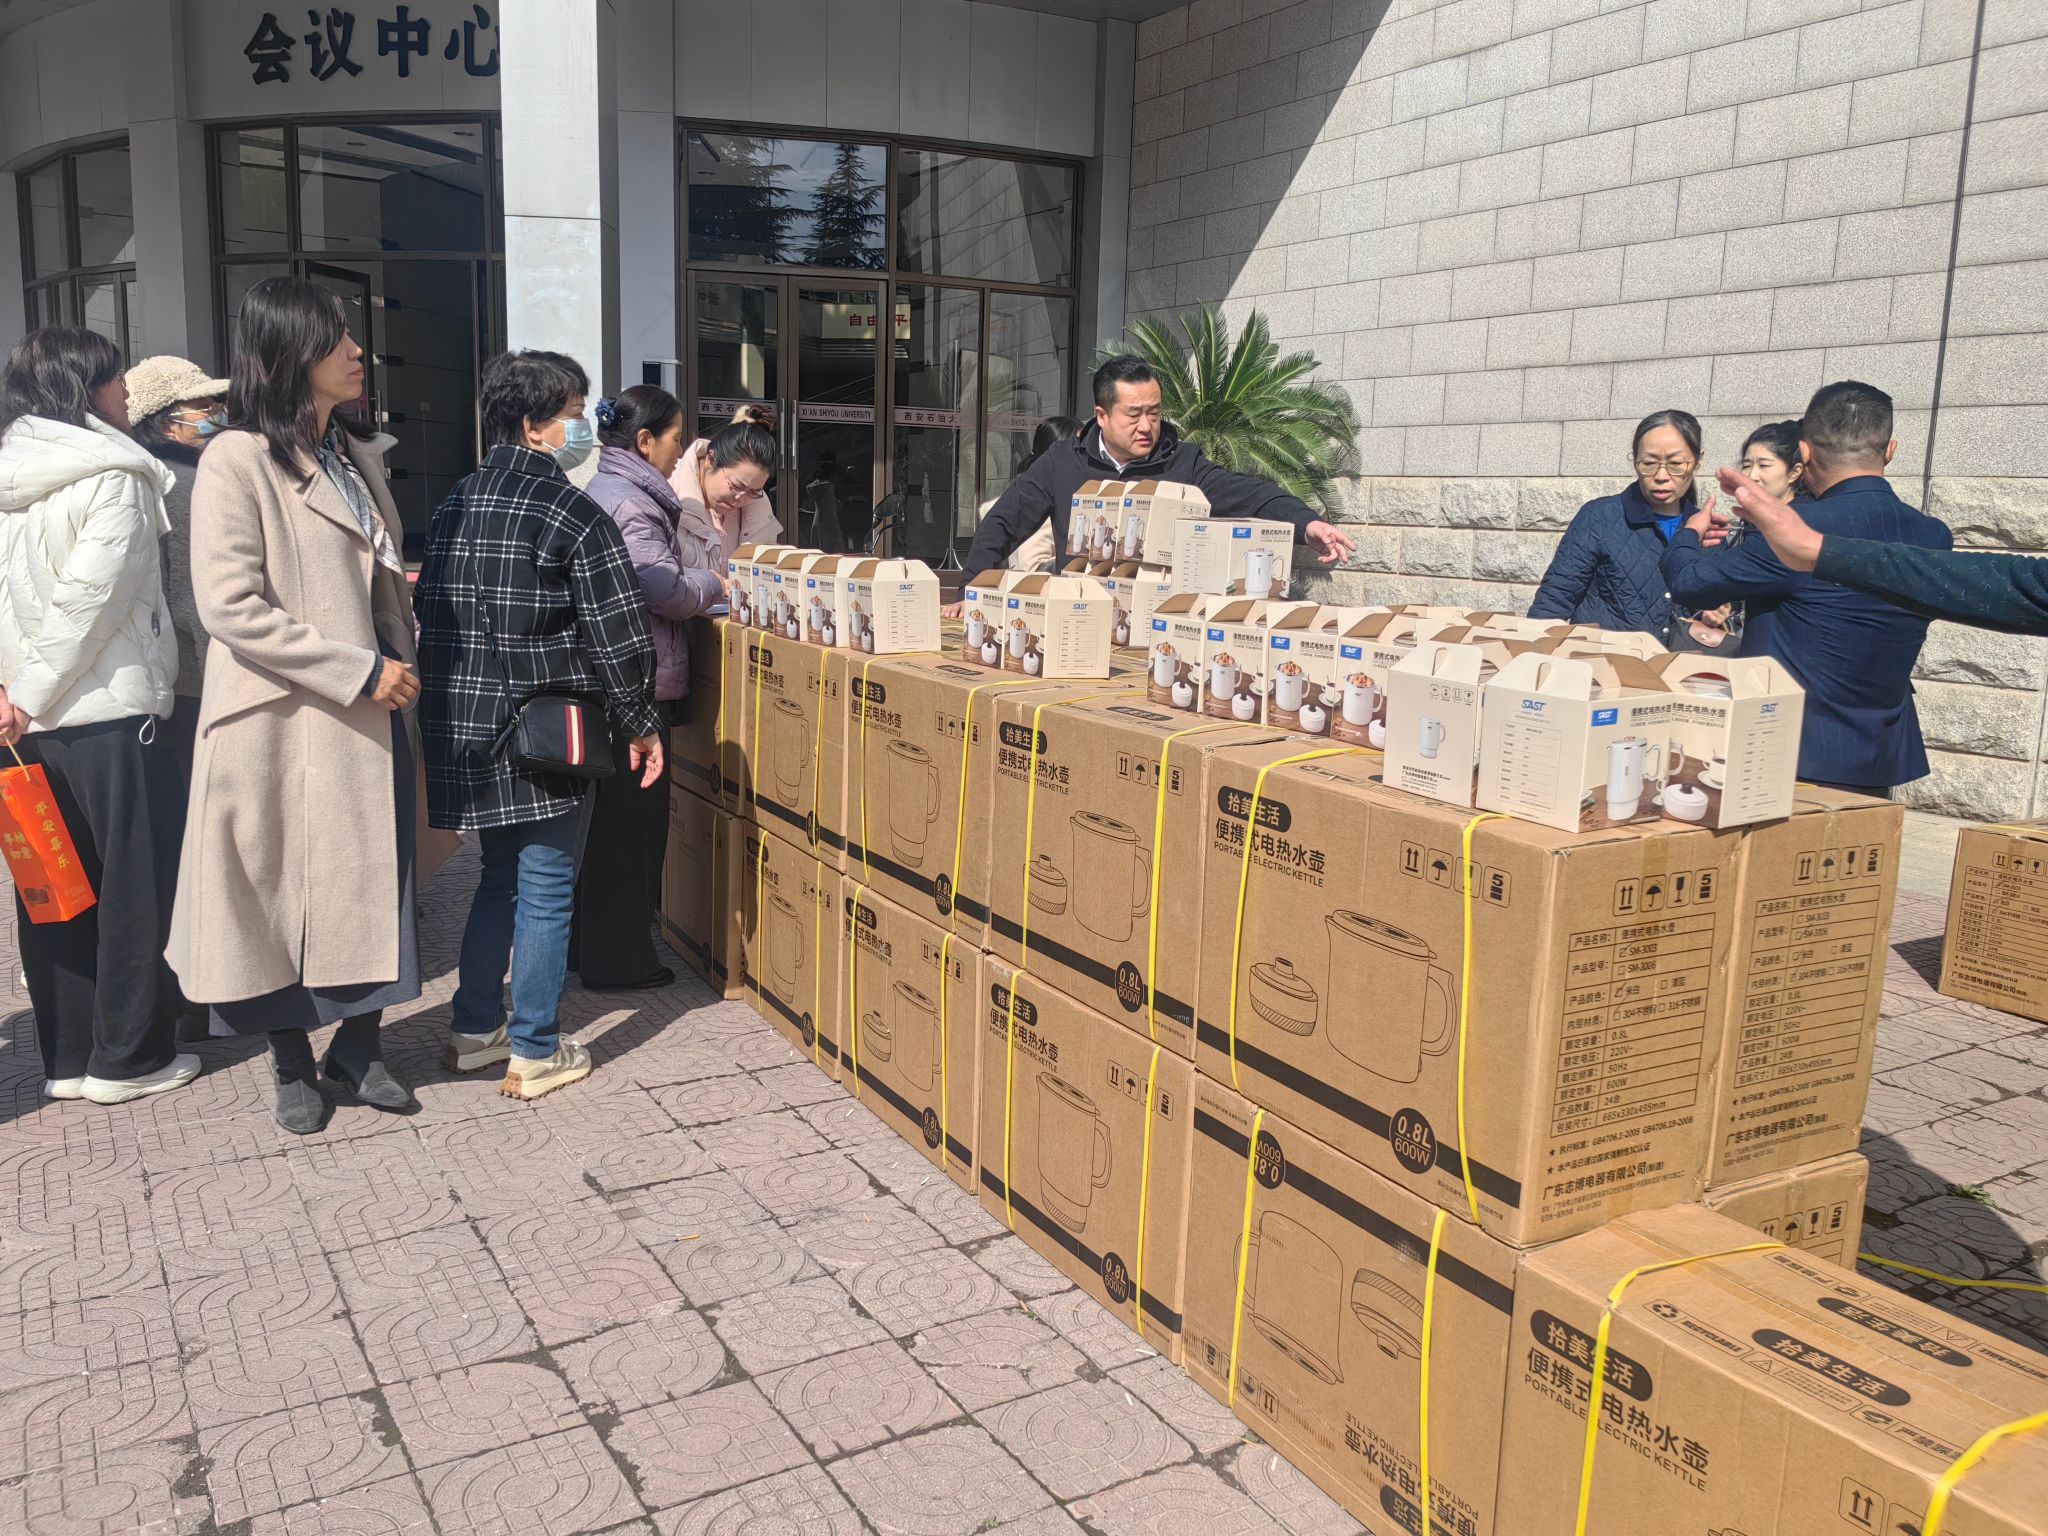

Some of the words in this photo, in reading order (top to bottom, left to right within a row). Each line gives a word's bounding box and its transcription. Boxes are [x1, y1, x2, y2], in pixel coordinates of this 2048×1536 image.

[244, 4, 499, 85] 会议中心
[819, 410, 839, 418] SHIYOU
[840, 411, 872, 420] UNIVERSITY
[904, 412, 957, 424] 西安石油大
[1373, 652, 1403, 663] 便携式电热
[1521, 699, 1548, 712] SAST
[1760, 703, 1779, 714] SAST
[1598, 711, 1613, 719] SAST
[1049, 782, 1069, 796] KETTLE
[1228, 793, 1280, 826] 拾美生活
[1868, 848, 1878, 860] 5
[1214, 841, 1251, 862] PORTABE
[1253, 855, 1291, 876] ELECTRIC
[1292, 869, 1324, 888] KETTLE
[1492, 873, 1504, 887] 5
[1701, 873, 1712, 886] 5
[1574, 933, 1612, 947] 产品名称：
[1119, 967, 1140, 991] 0.8L
[1118, 986, 1140, 1005] 600W
[1611, 1030, 1628, 1041] 0.8L
[1037, 1056, 1058, 1073] KETTLE
[1607, 1062, 1628, 1074] 50Hz
[1606, 1078, 1628, 1090] 600W
[1398, 1115, 1432, 1149] 0.8L
[1395, 1136, 1430, 1166] 600W
[1833, 1206, 1843, 1218] 5
[1106, 1258, 1126, 1285] 0.8L
[1104, 1275, 1126, 1298] 600W
[1681, 1319, 1744, 1355] RECYCLABLE
[1837, 1305, 1951, 1358] 拾美生活
[1771, 1338, 1887, 1397] 拾美生活
[1345, 1411, 1378, 1443] KETTLE
[1524, 1375, 1586, 1421] PORTABLE
[1597, 1421, 1651, 1459] LECTRIC
[1653, 1451, 1707, 1493] KETTLE
[1379, 1438, 1420, 1475] LECTRIC
